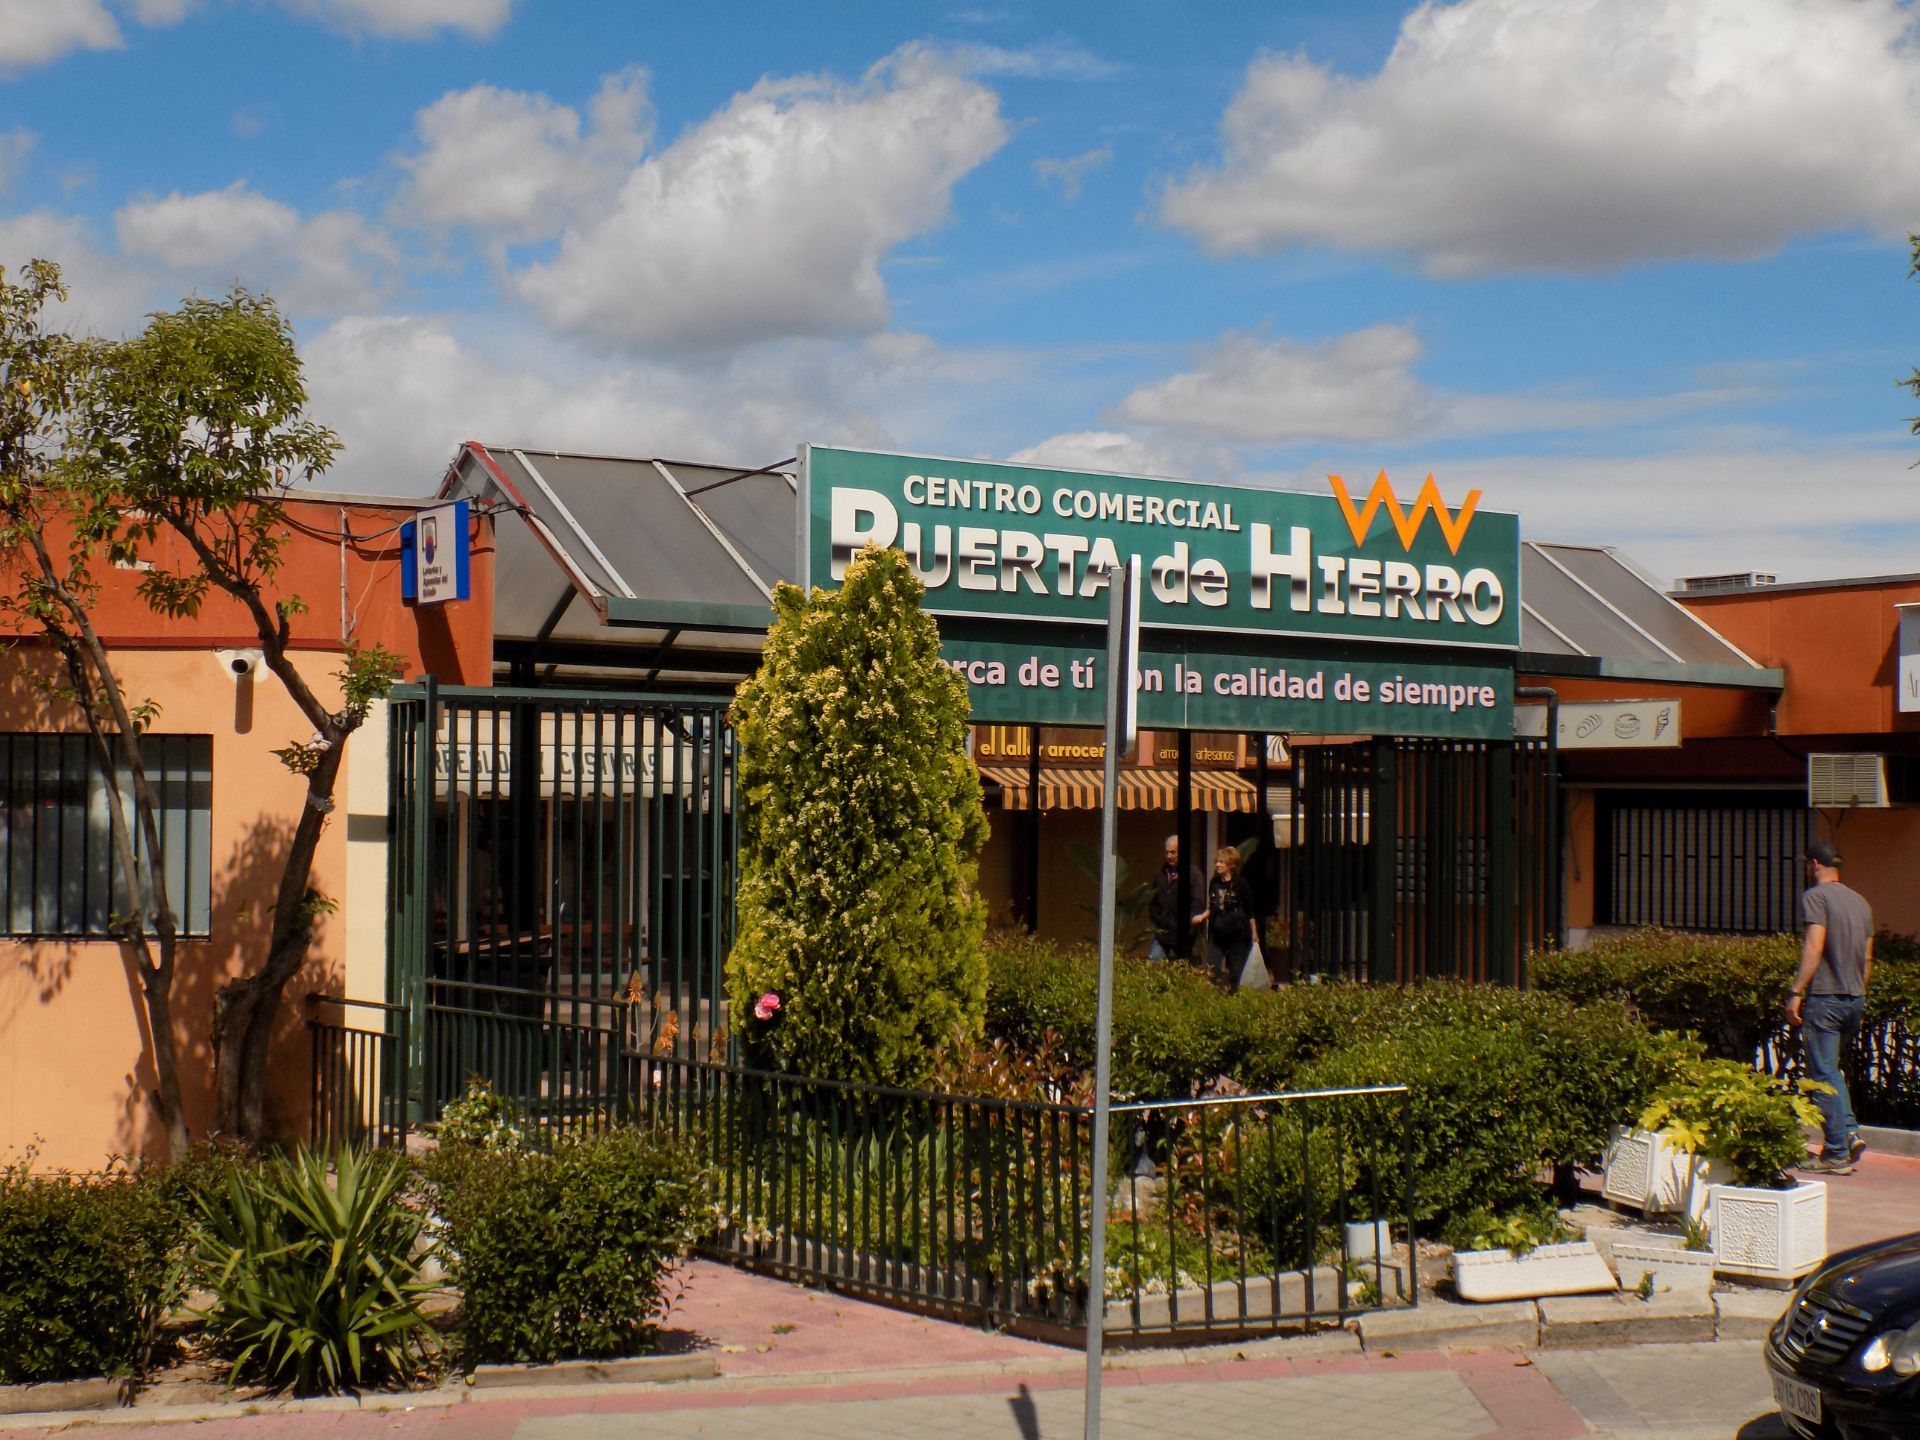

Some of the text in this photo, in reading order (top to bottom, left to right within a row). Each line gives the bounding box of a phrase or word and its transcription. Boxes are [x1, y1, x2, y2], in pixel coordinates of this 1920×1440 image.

[903, 475, 1240, 531] CENTRO COMERCIAL
[831, 487, 1504, 626] PUERTA de HIERRO
[1018, 656, 1060, 687] de
[1070, 656, 1096, 689] tí
[1175, 663, 1202, 694] la
[1213, 667, 1324, 700] calidad
[1334, 672, 1370, 702] de
[1379, 675, 1496, 712] siempre
